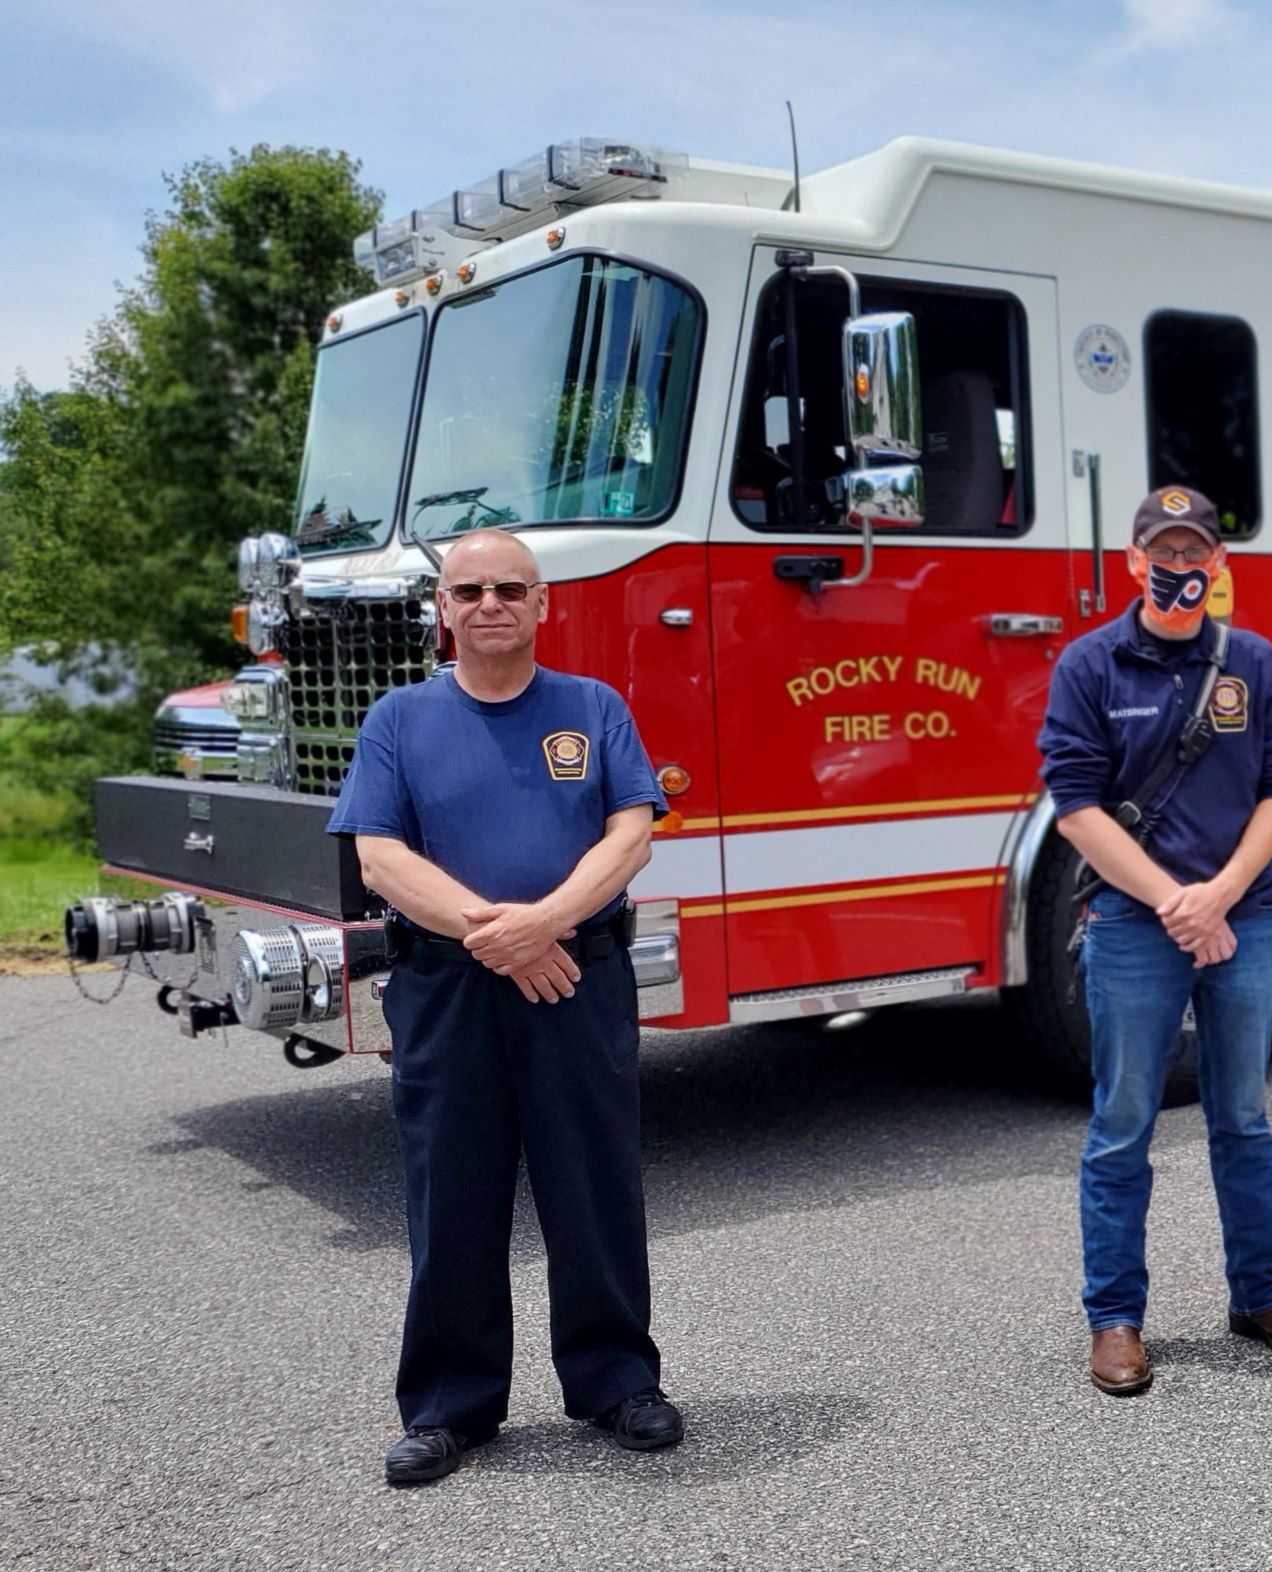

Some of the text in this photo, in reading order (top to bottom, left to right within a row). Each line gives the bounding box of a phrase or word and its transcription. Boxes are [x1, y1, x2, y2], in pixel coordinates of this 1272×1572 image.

[785, 655, 982, 707] ROCKY RUN
[824, 711, 957, 743] FIRE CO.
